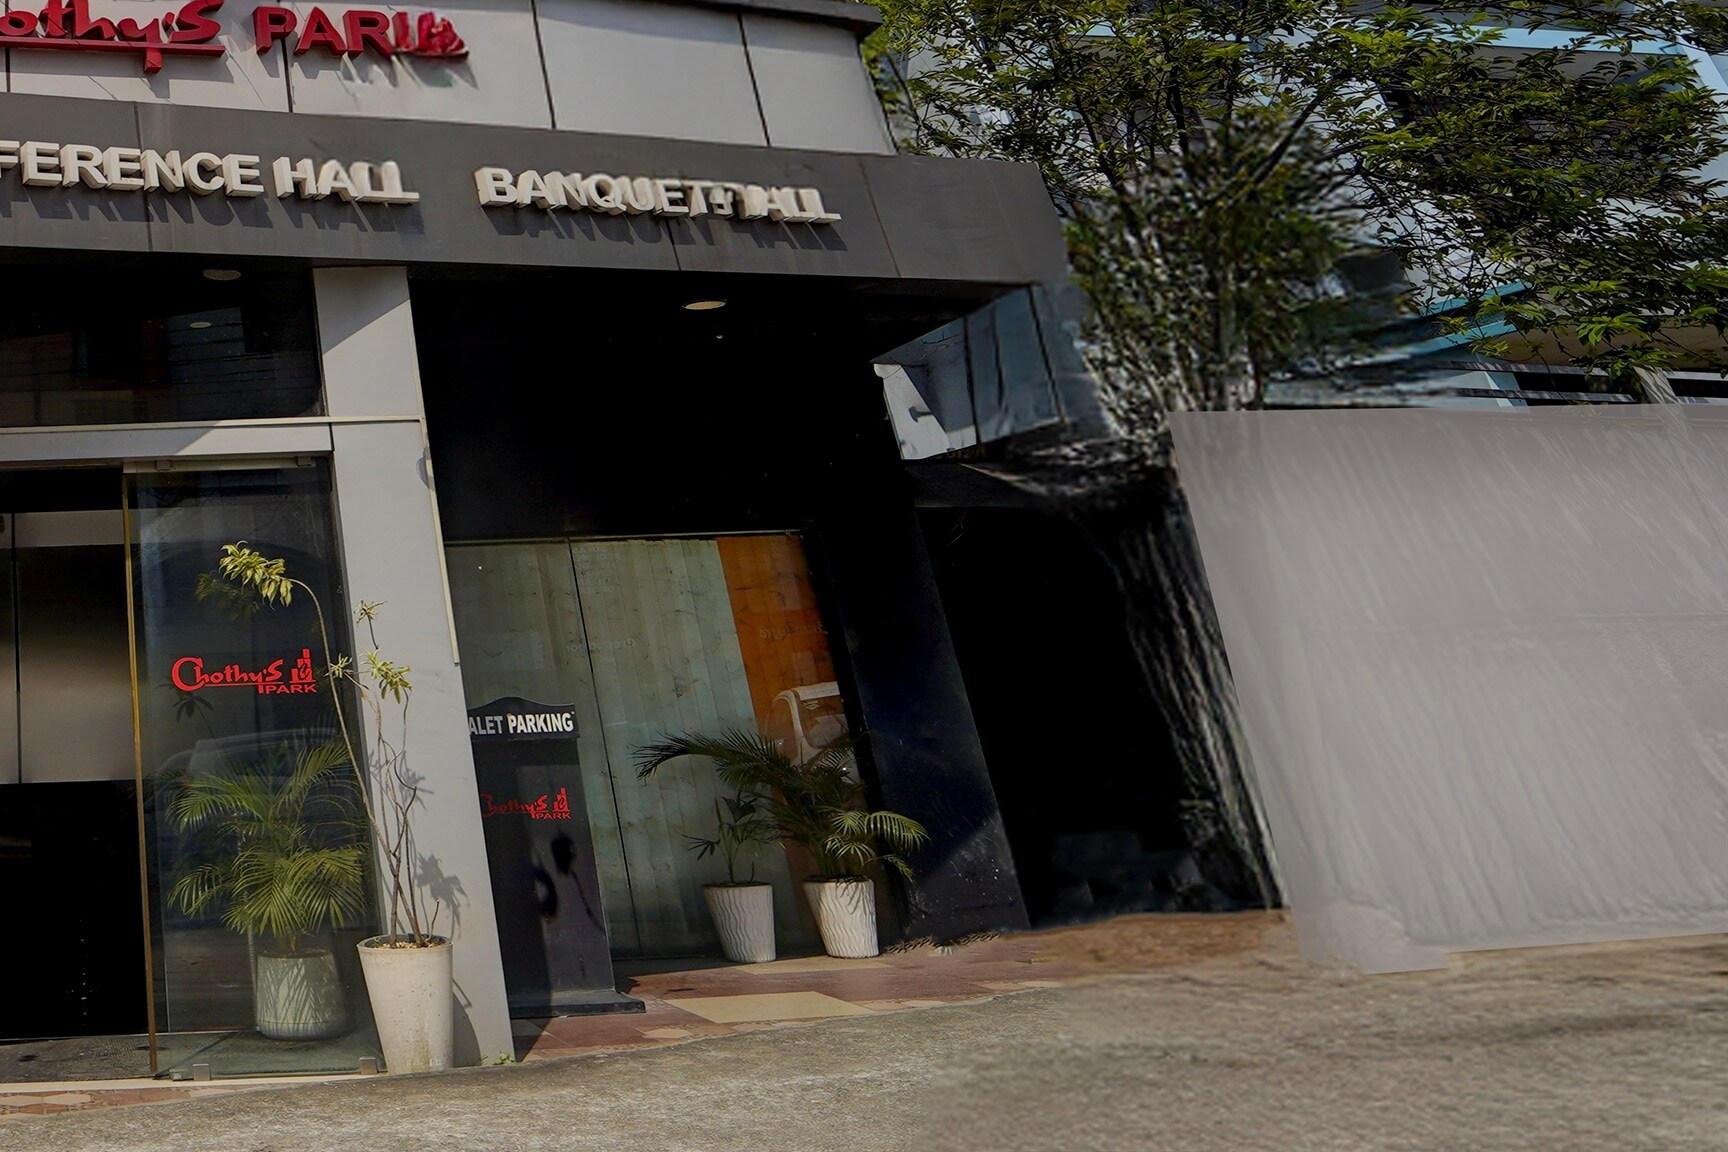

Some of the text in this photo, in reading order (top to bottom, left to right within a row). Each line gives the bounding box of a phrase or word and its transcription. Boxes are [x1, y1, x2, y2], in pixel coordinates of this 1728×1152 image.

[274, 154, 421, 205] HALL
[264, 684, 318, 694] PARK
[468, 712, 574, 736] ALET PARKING
